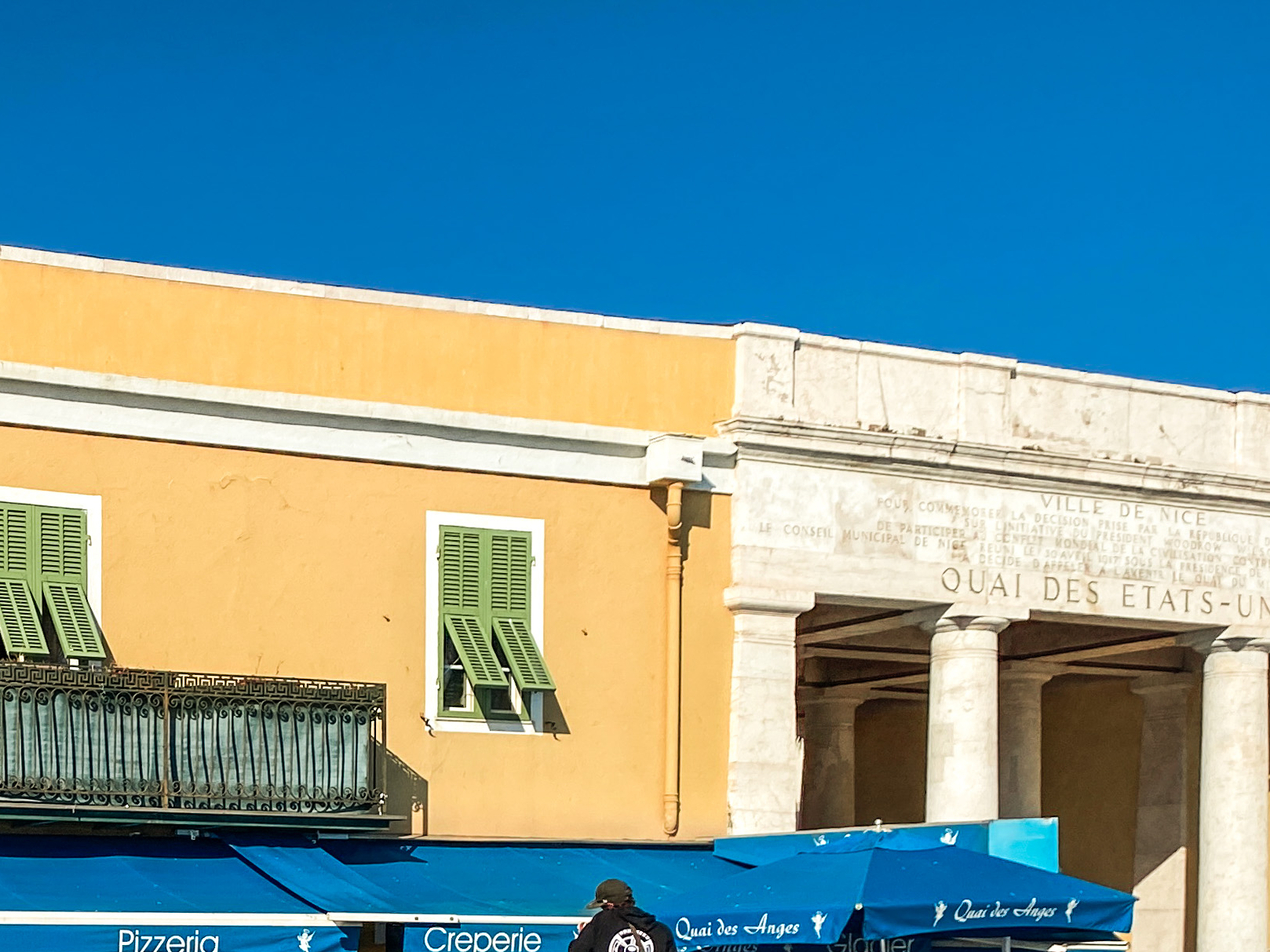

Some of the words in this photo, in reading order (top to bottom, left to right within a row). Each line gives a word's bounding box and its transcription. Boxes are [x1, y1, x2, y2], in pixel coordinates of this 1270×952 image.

[1011, 511, 1026, 521] LA
[1034, 512, 1089, 527] DECISION
[1098, 519, 1128, 532] PRISE
[1138, 523, 1157, 535] PAR
[1168, 527, 1181, 537] LA
[1040, 494, 1104, 515] VILLE
[1119, 502, 1145, 520] DE
[1160, 507, 1206, 526] NICE
[758, 522, 772, 534] LE
[783, 524, 834, 539] CONSEIL
[842, 529, 906, 545] MUNICIPAL
[914, 535, 928, 547] DE
[938, 538, 966, 551] NICE
[1180, 562, 1241, 576] PRESIDENCE
[877, 520, 892, 531] DE
[899, 523, 965, 539] PARTICIPER
[1113, 542, 1126, 553] DE
[1132, 545, 1144, 555] LA
[1073, 528, 1088, 539] DU
[1097, 530, 1153, 544] PRESIDENT
[1164, 539, 1221, 552] WOODROW
[979, 553, 1021, 568] DECIDE
[941, 567, 1021, 598] QUAI
[1044, 576, 1099, 605] DES
[1122, 583, 1270, 620] ETATS-UN
[954, 899, 987, 922] Quai
[990, 901, 1010, 918] des
[1012, 897, 1058, 922] Anges
[676, 917, 712, 940] Quai
[717, 918, 738, 936] des
[743, 912, 800, 939] Anges
